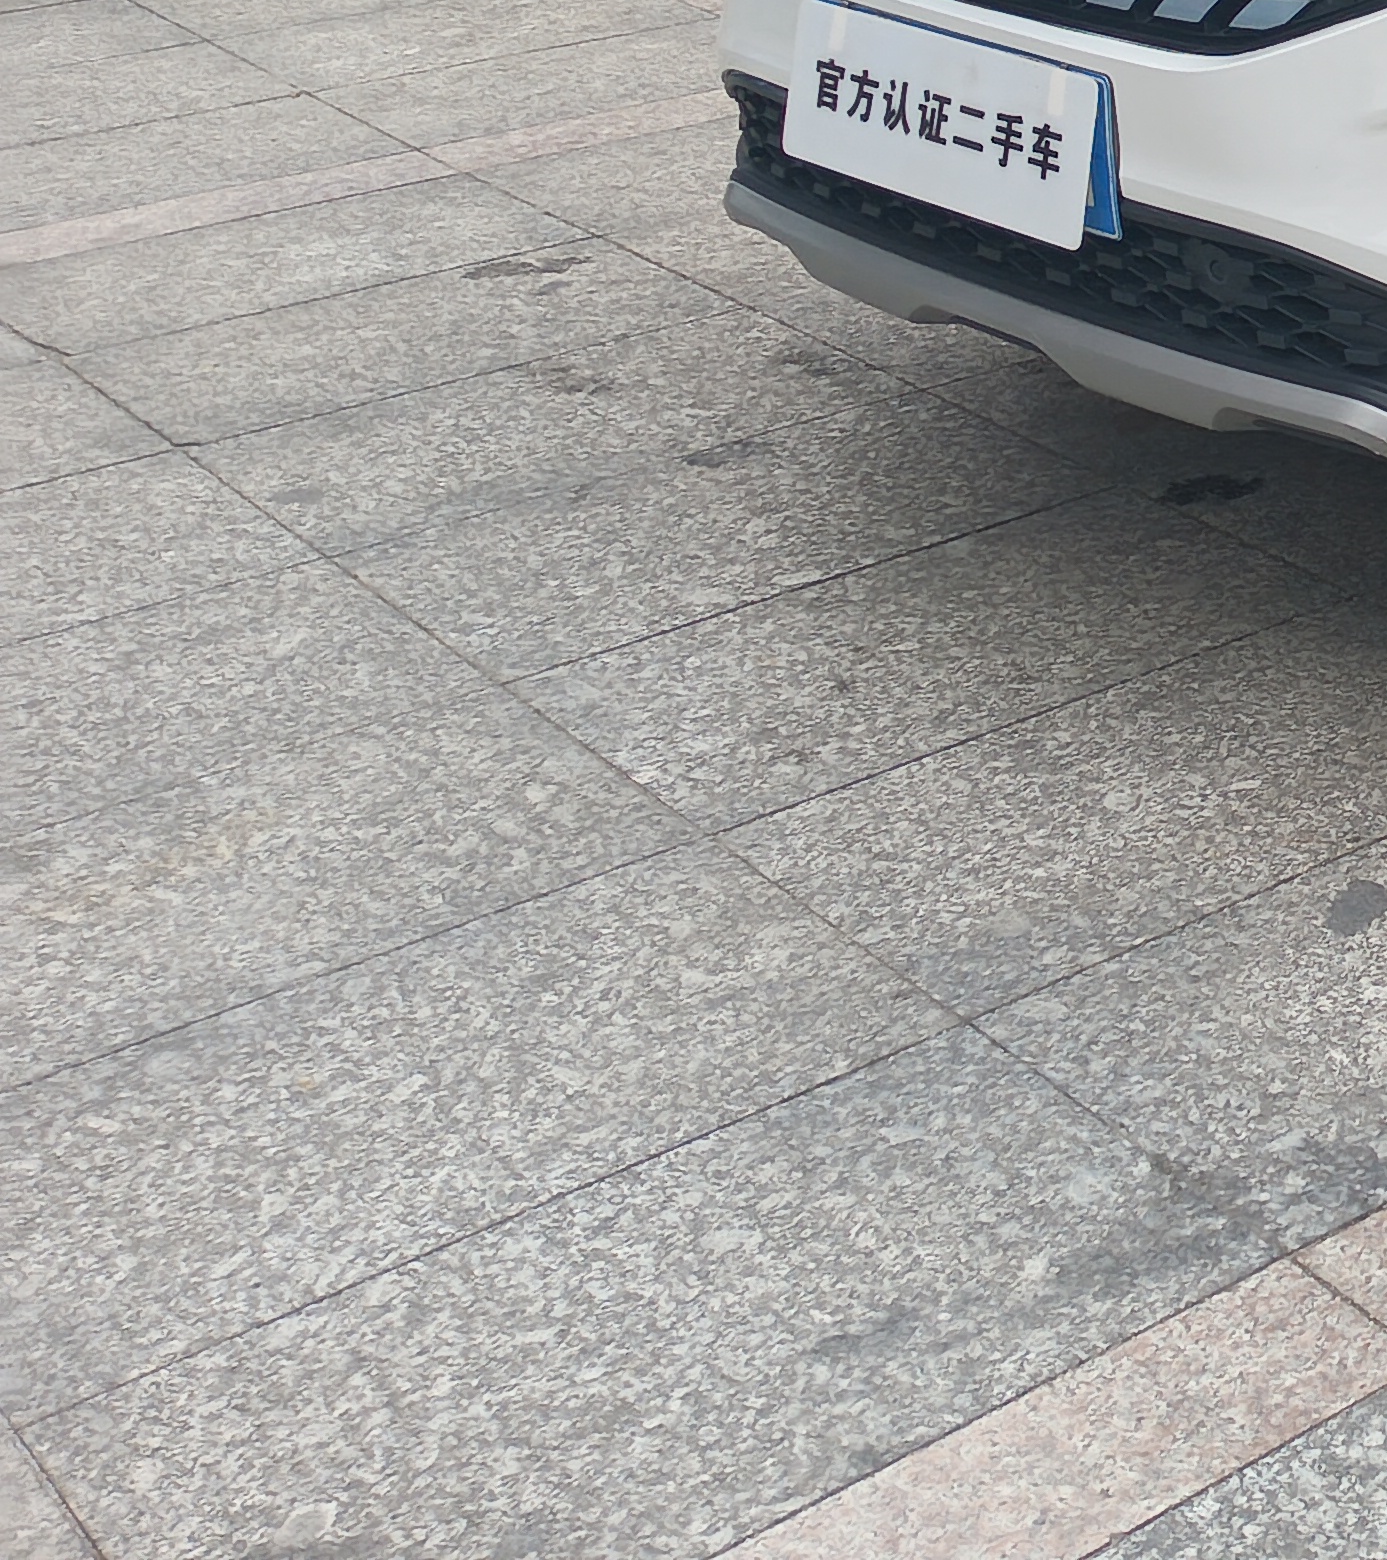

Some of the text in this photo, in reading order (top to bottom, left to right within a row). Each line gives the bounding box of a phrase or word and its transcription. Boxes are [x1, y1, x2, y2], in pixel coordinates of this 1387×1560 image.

[816, 58, 1063, 180] 官方认证二手车
